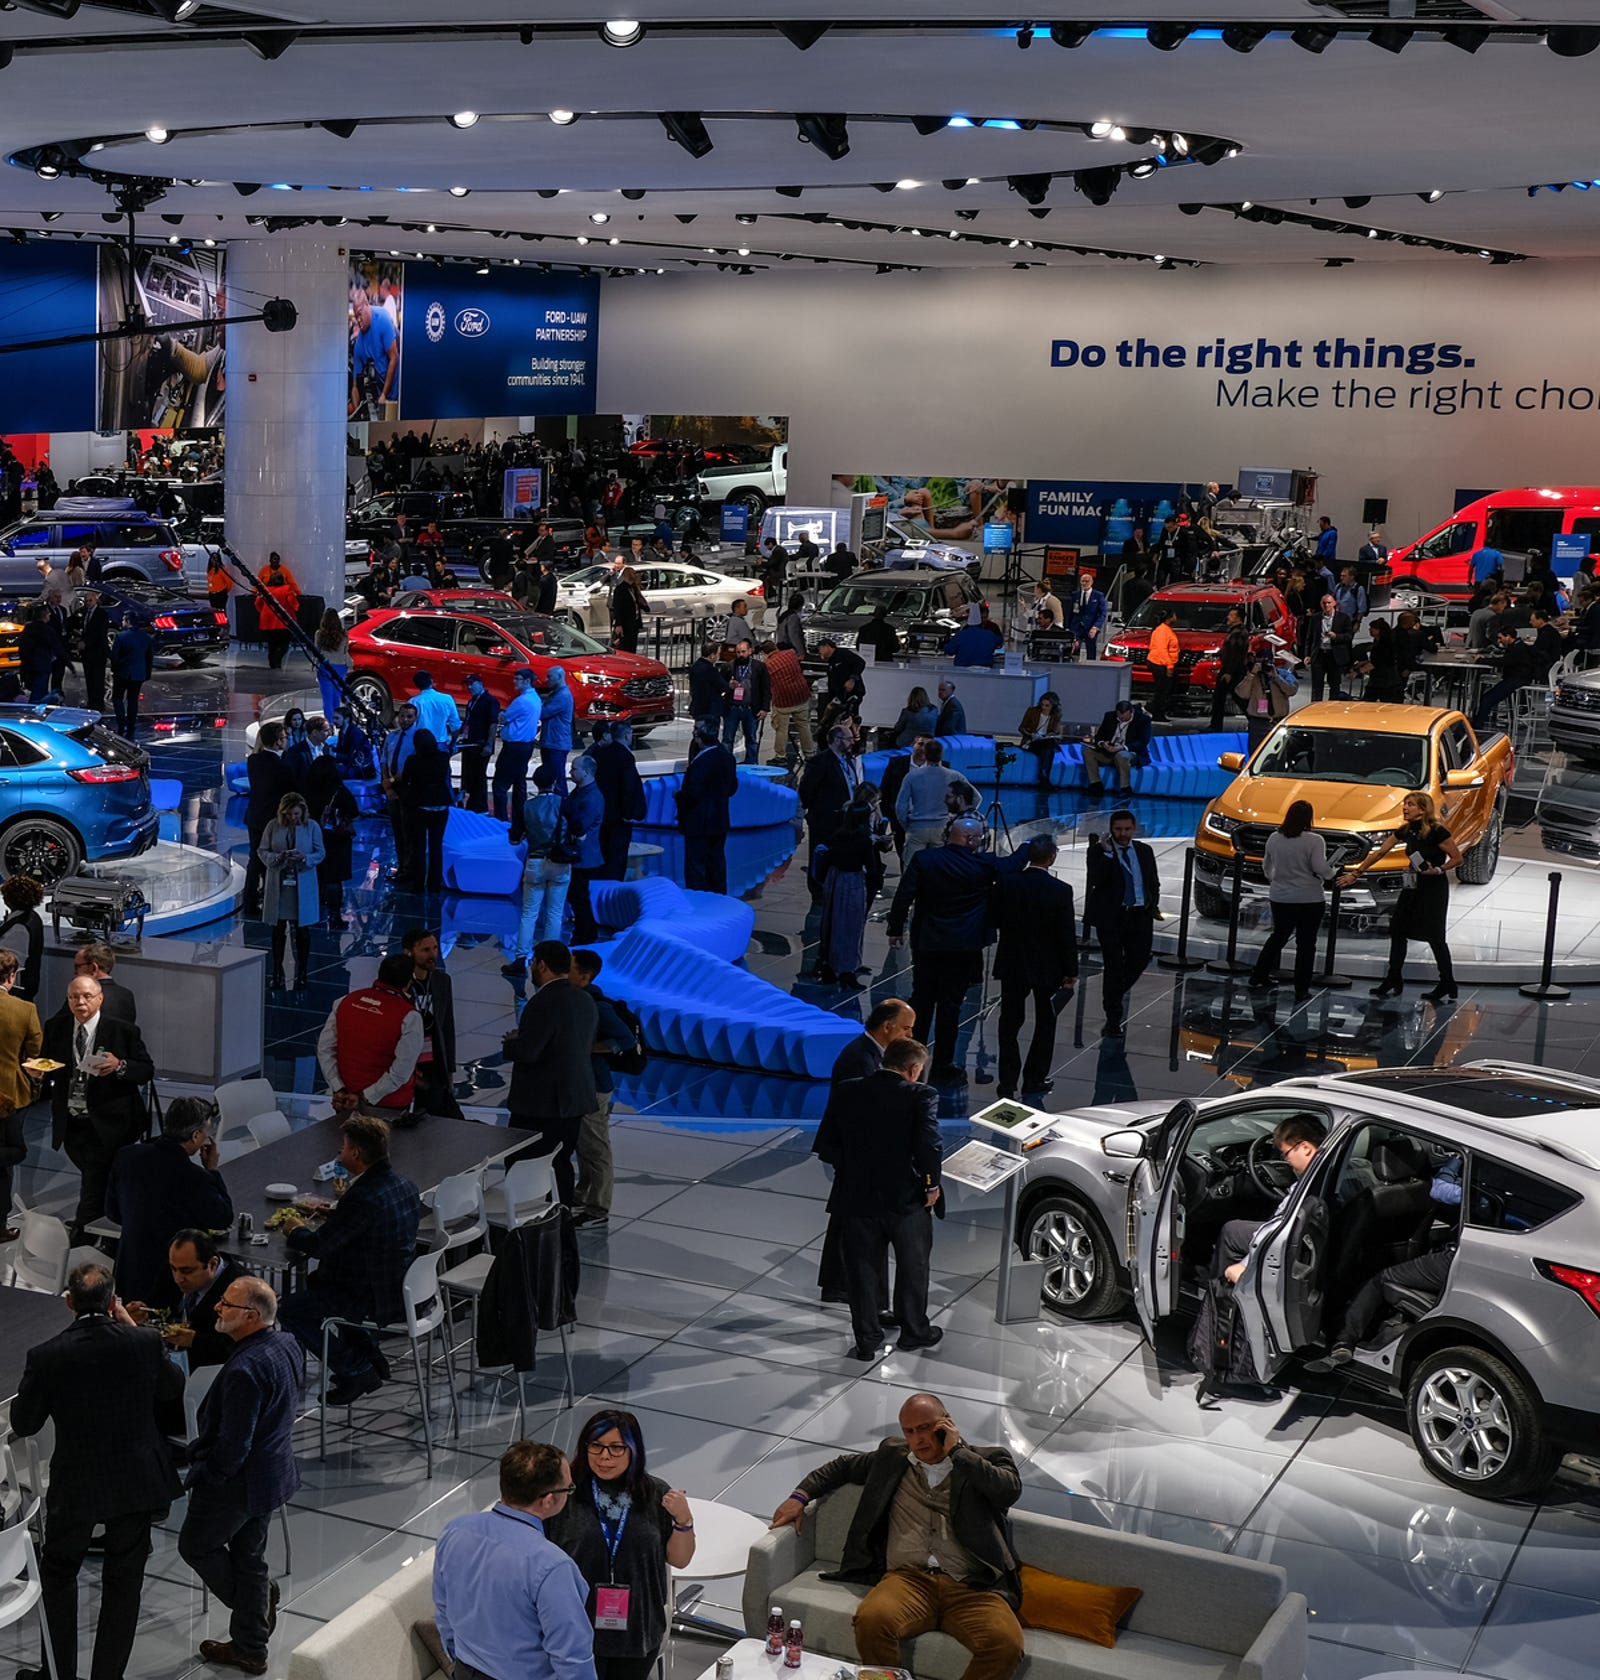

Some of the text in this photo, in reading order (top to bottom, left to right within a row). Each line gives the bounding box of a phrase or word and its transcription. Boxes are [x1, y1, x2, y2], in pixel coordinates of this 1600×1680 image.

[460, 311, 485, 333] Ford
[535, 327, 588, 343] PARTNERSHIP
[1050, 337, 1476, 375] Do the right things.
[531, 357, 586, 374] Building stronger
[507, 373, 552, 387] communities
[552, 374, 570, 386] since
[1216, 378, 1319, 408] Make
[1331, 378, 1396, 409] the
[1409, 378, 1503, 416] right
[1039, 491, 1094, 503] FAMILY
[1038, 504, 1069, 516] FUN
